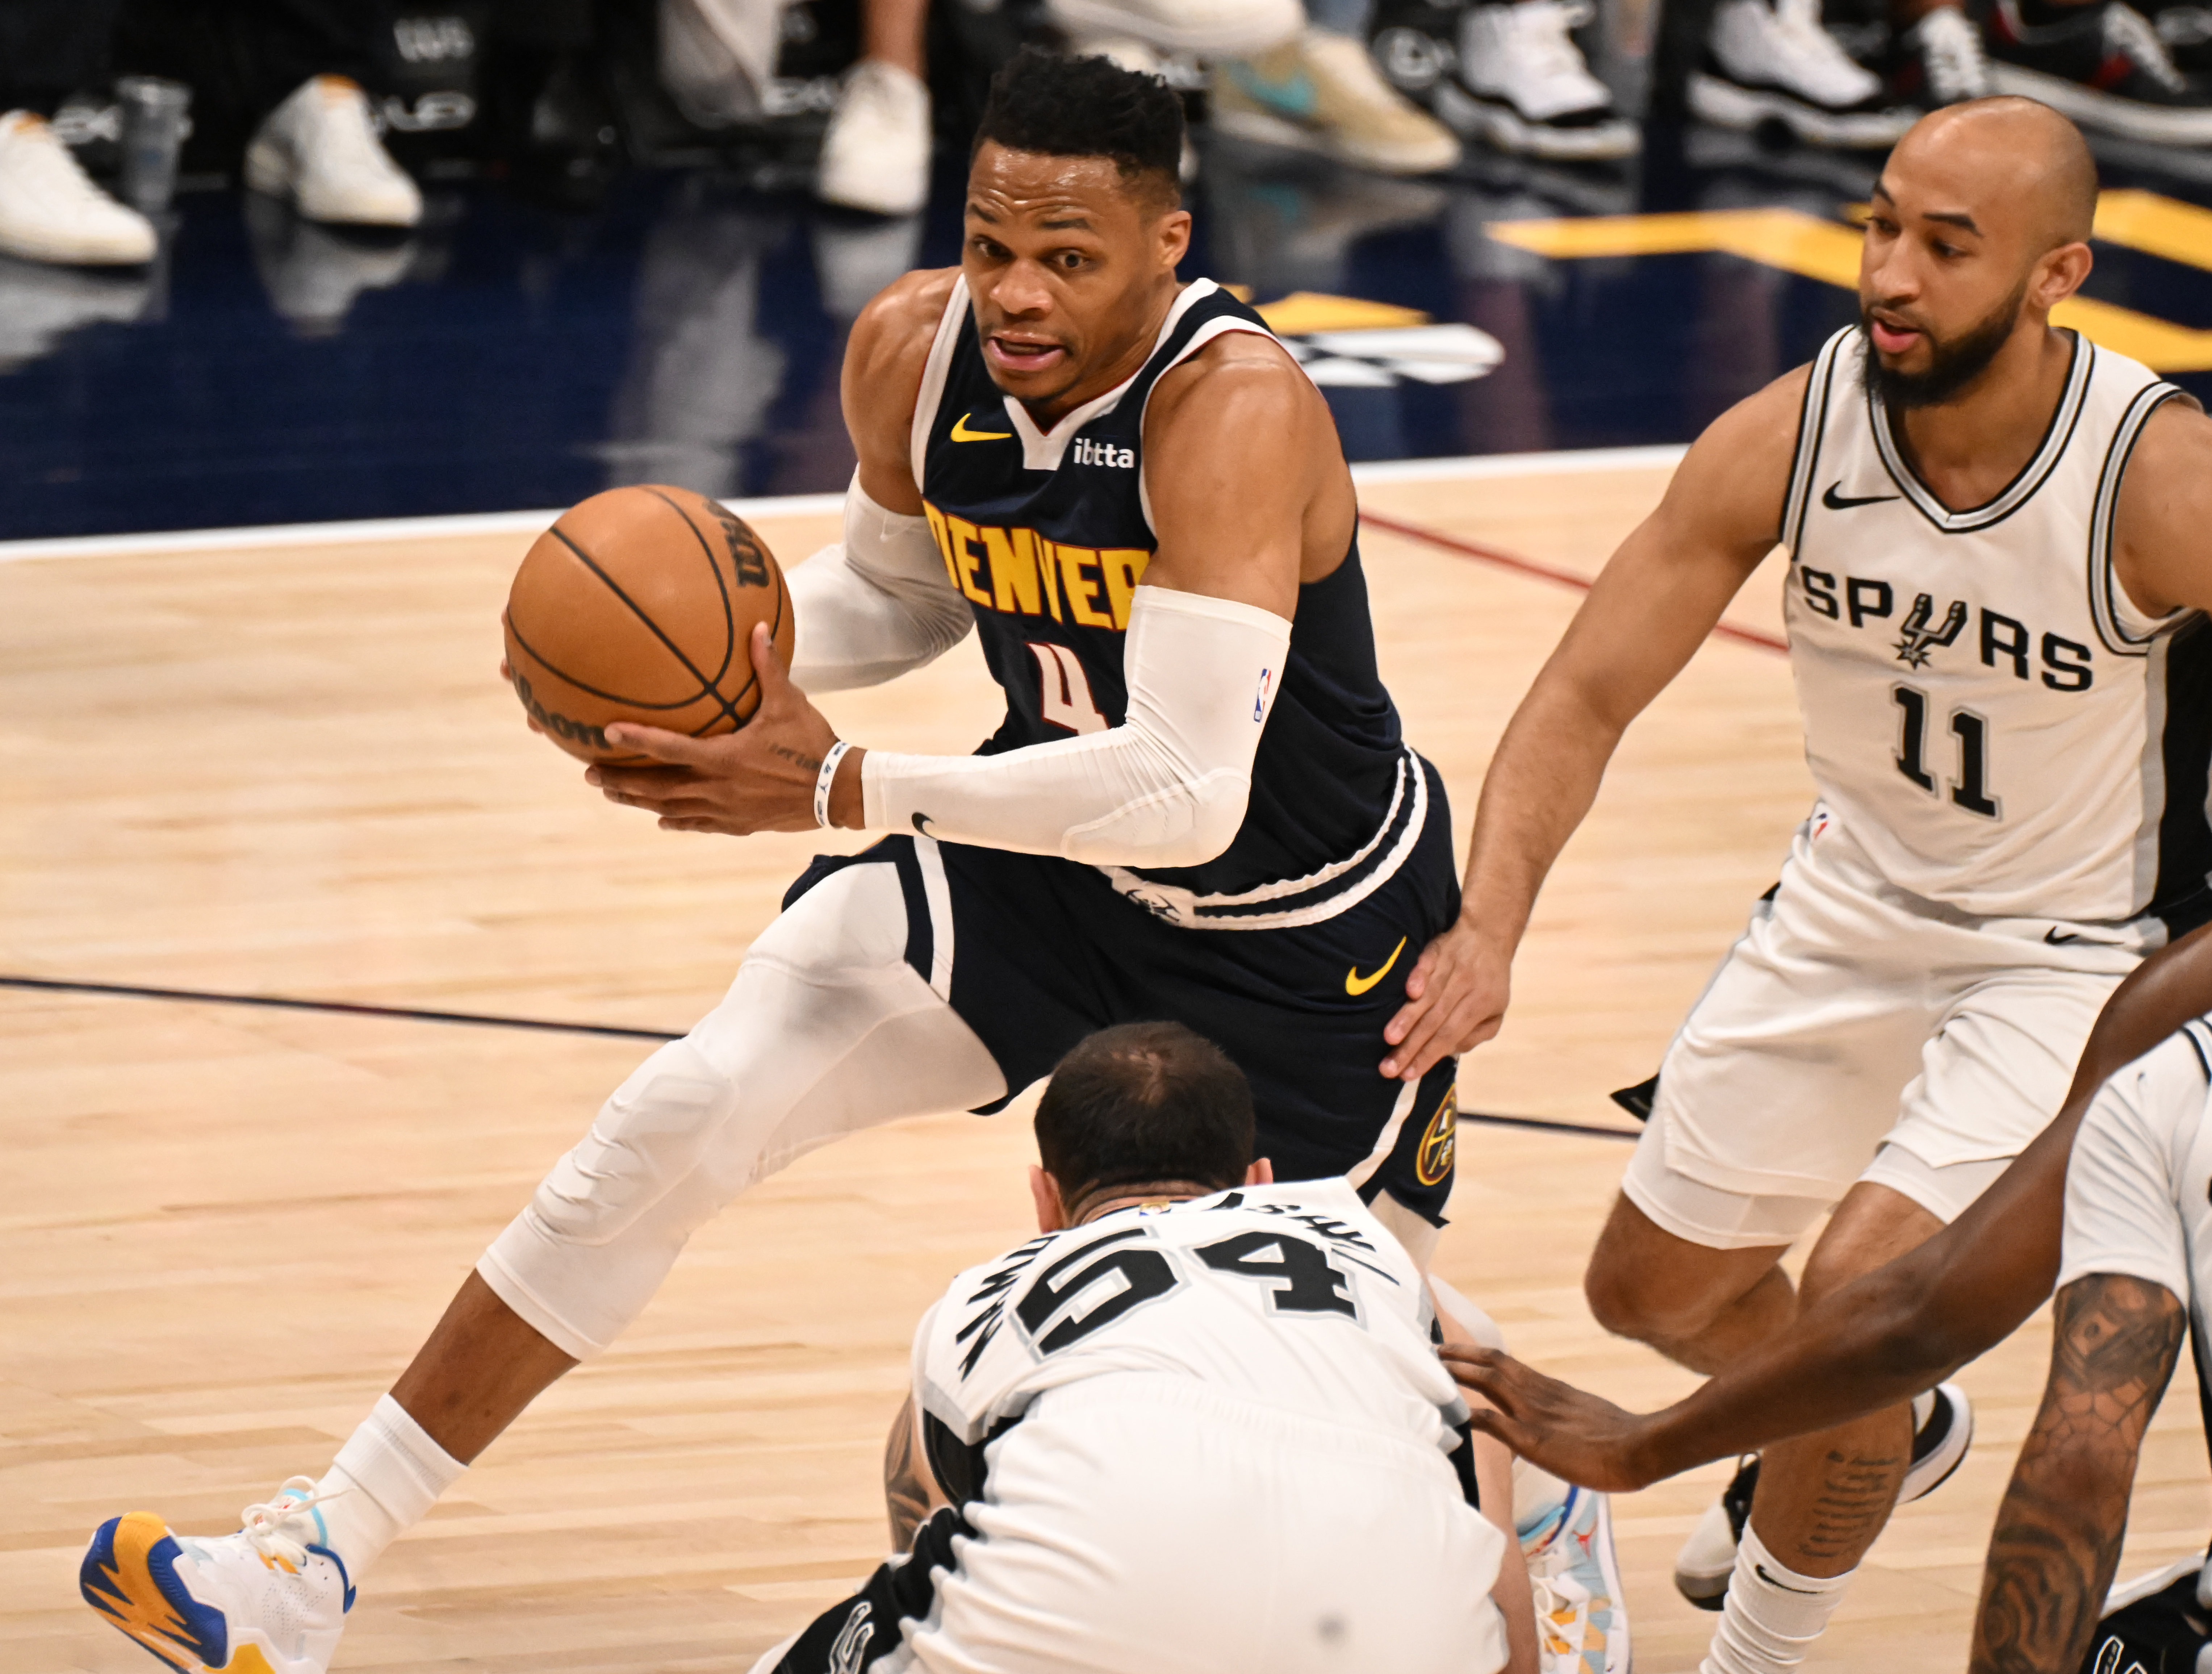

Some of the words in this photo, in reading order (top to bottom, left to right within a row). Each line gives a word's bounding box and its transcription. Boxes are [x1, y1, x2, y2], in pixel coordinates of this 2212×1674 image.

[1074, 438, 1135, 468] ibtta
[1025, 642, 1111, 735] 4
[1801, 565, 2093, 692] SPURS
[1890, 681, 2002, 822] 11
[1009, 1225, 1366, 1364] 54
